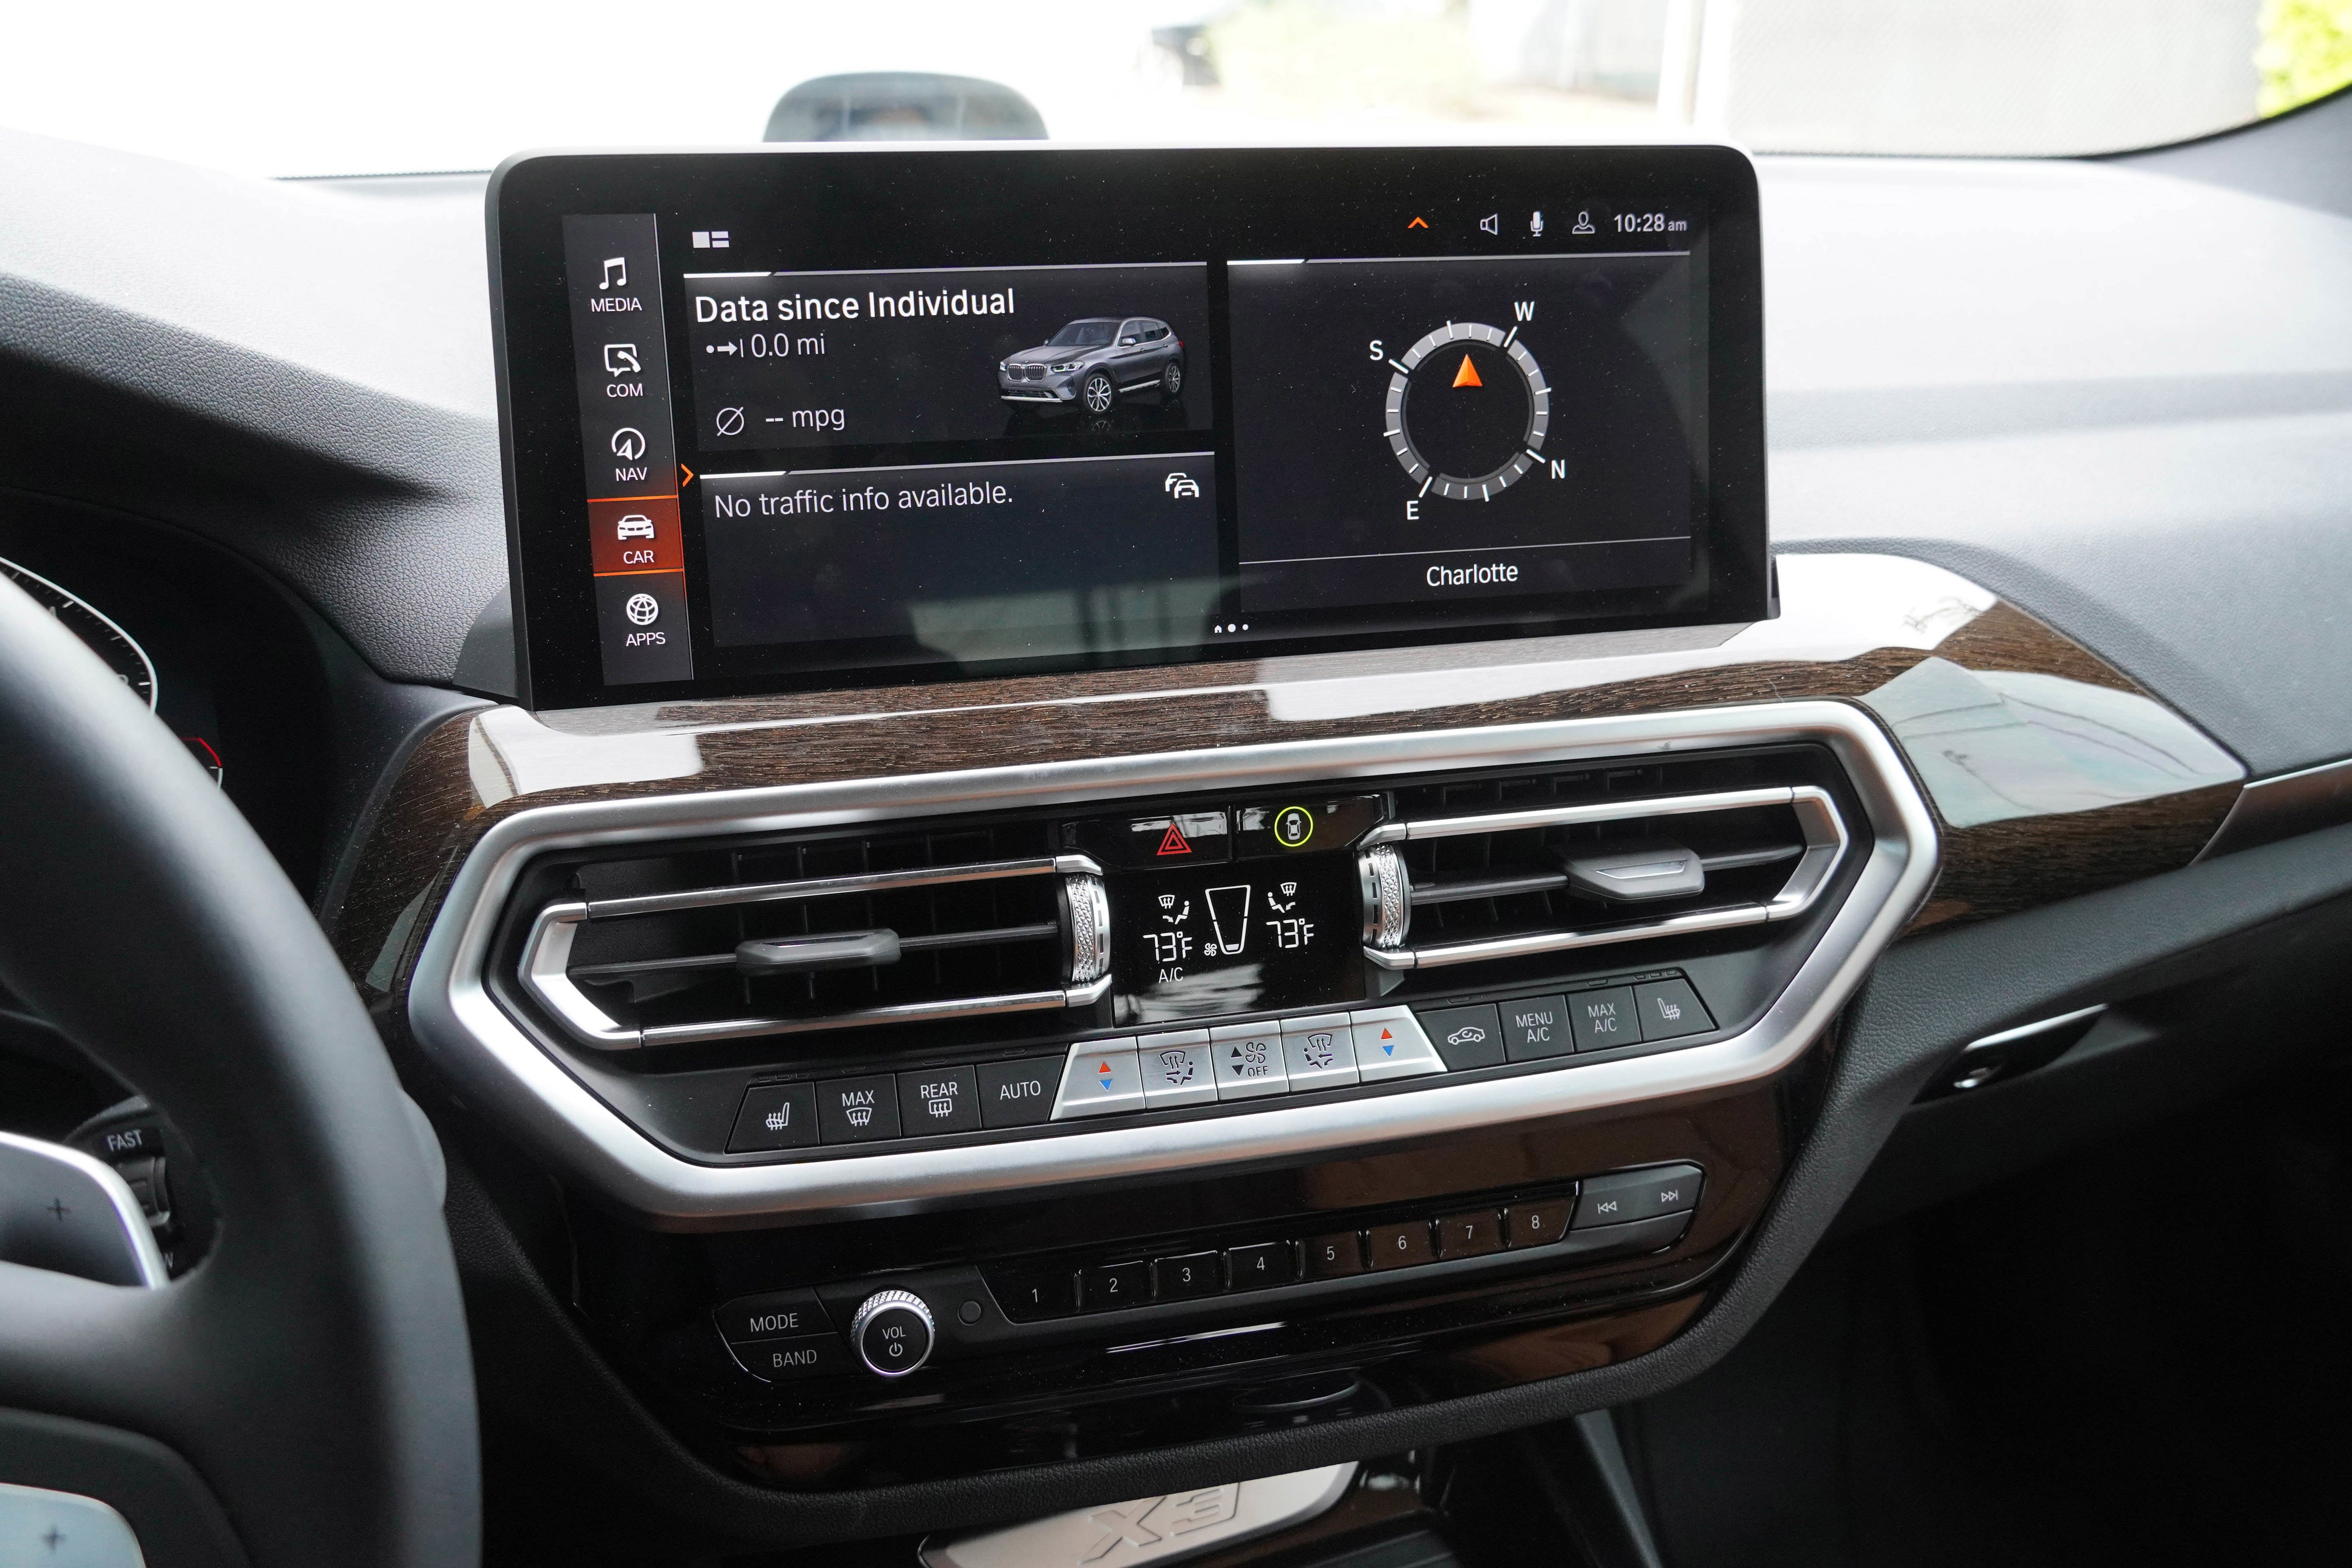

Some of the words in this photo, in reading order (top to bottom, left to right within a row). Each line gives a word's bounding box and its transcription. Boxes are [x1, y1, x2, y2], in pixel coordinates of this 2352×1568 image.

[1614, 213, 1665, 232] 10:28
[1668, 221, 1687, 231] am
[591, 297, 642, 312] MEDIA
[695, 296, 768, 323] Data
[778, 294, 859, 321] since
[869, 288, 1014, 317] Individual
[1514, 301, 1535, 321] W
[751, 333, 789, 358] 0.0
[797, 333, 825, 355] mi
[1370, 340, 1383, 361] S
[606, 383, 643, 397] COM
[792, 409, 844, 432] mpg
[615, 467, 647, 481] NAV
[1551, 459, 1565, 479] N
[715, 494, 751, 518] No
[759, 489, 834, 515] traffic
[842, 486, 889, 511] info
[898, 481, 1012, 509] available.
[1407, 500, 1419, 520] E
[623, 550, 655, 564] CAR
[1426, 563, 1518, 586] Charlotte
[626, 632, 666, 647] APPS
[1158, 967, 1183, 983] A/C
[1588, 1002, 1616, 1018] MAX
[1515, 1011, 1553, 1027] MENU
[1595, 1017, 1617, 1033] A/C
[1527, 1027, 1550, 1043] A/C
[1247, 1065, 1269, 1078] OFF
[920, 1082, 958, 1099] REAR
[1000, 1080, 1041, 1100] AUTO
[842, 1090, 874, 1107] MAX
[107, 1129, 142, 1151] FAST
[1532, 1215, 1540, 1229] 8
[1466, 1225, 1473, 1239] 7
[1398, 1235, 1407, 1250] 6
[1327, 1246, 1335, 1261] 5
[1256, 1256, 1265, 1270] 4
[1182, 1267, 1191, 1282] 3
[1109, 1278, 1118, 1292] 2
[1032, 1288, 1038, 1303] 1
[750, 1313, 799, 1332] MODE
[882, 1326, 906, 1339] VOL
[773, 1350, 817, 1368] BAND
[1078, 1482, 1240, 1565] X3
